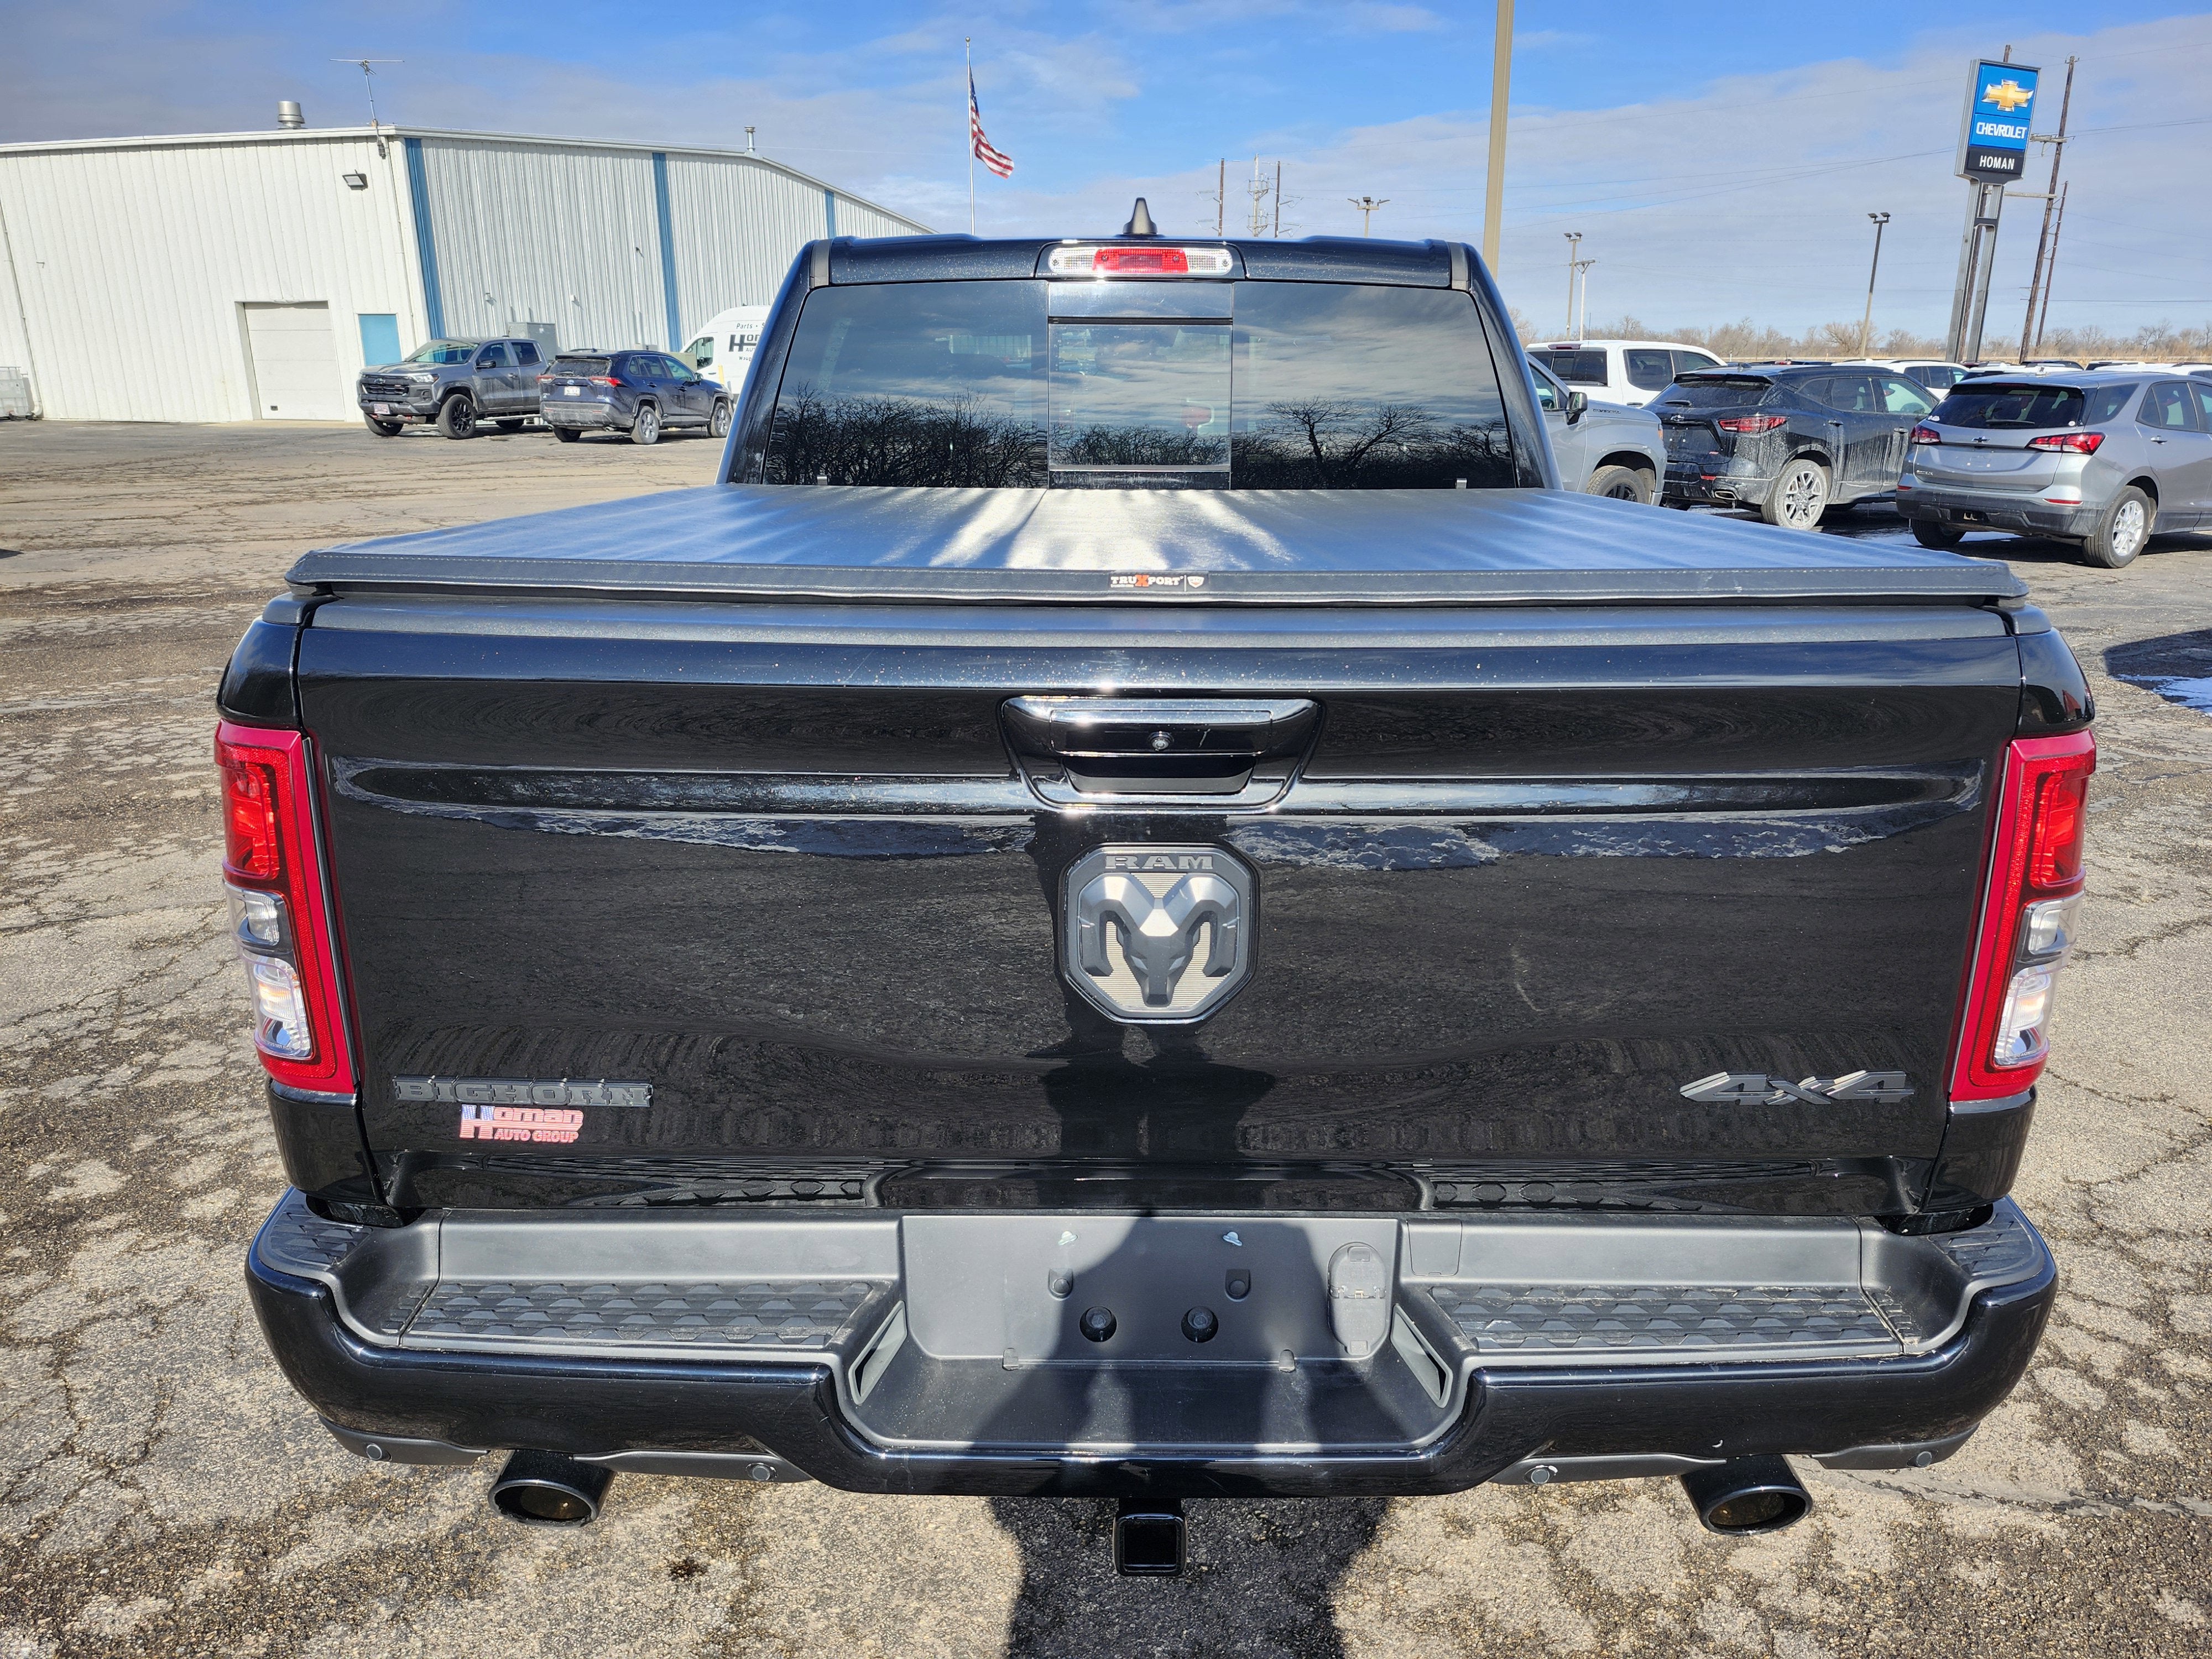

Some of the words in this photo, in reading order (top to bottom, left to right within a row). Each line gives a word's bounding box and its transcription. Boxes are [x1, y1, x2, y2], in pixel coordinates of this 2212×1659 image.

[1976, 121, 2028, 139] CHEVROLET
[1979, 155, 2015, 170] HOMAN
[1110, 575, 1180, 587] TRUXPORT
[1105, 855, 1214, 869] RAM
[494, 1127, 531, 1141] AUTO
[532, 1129, 579, 1143] GROUP
